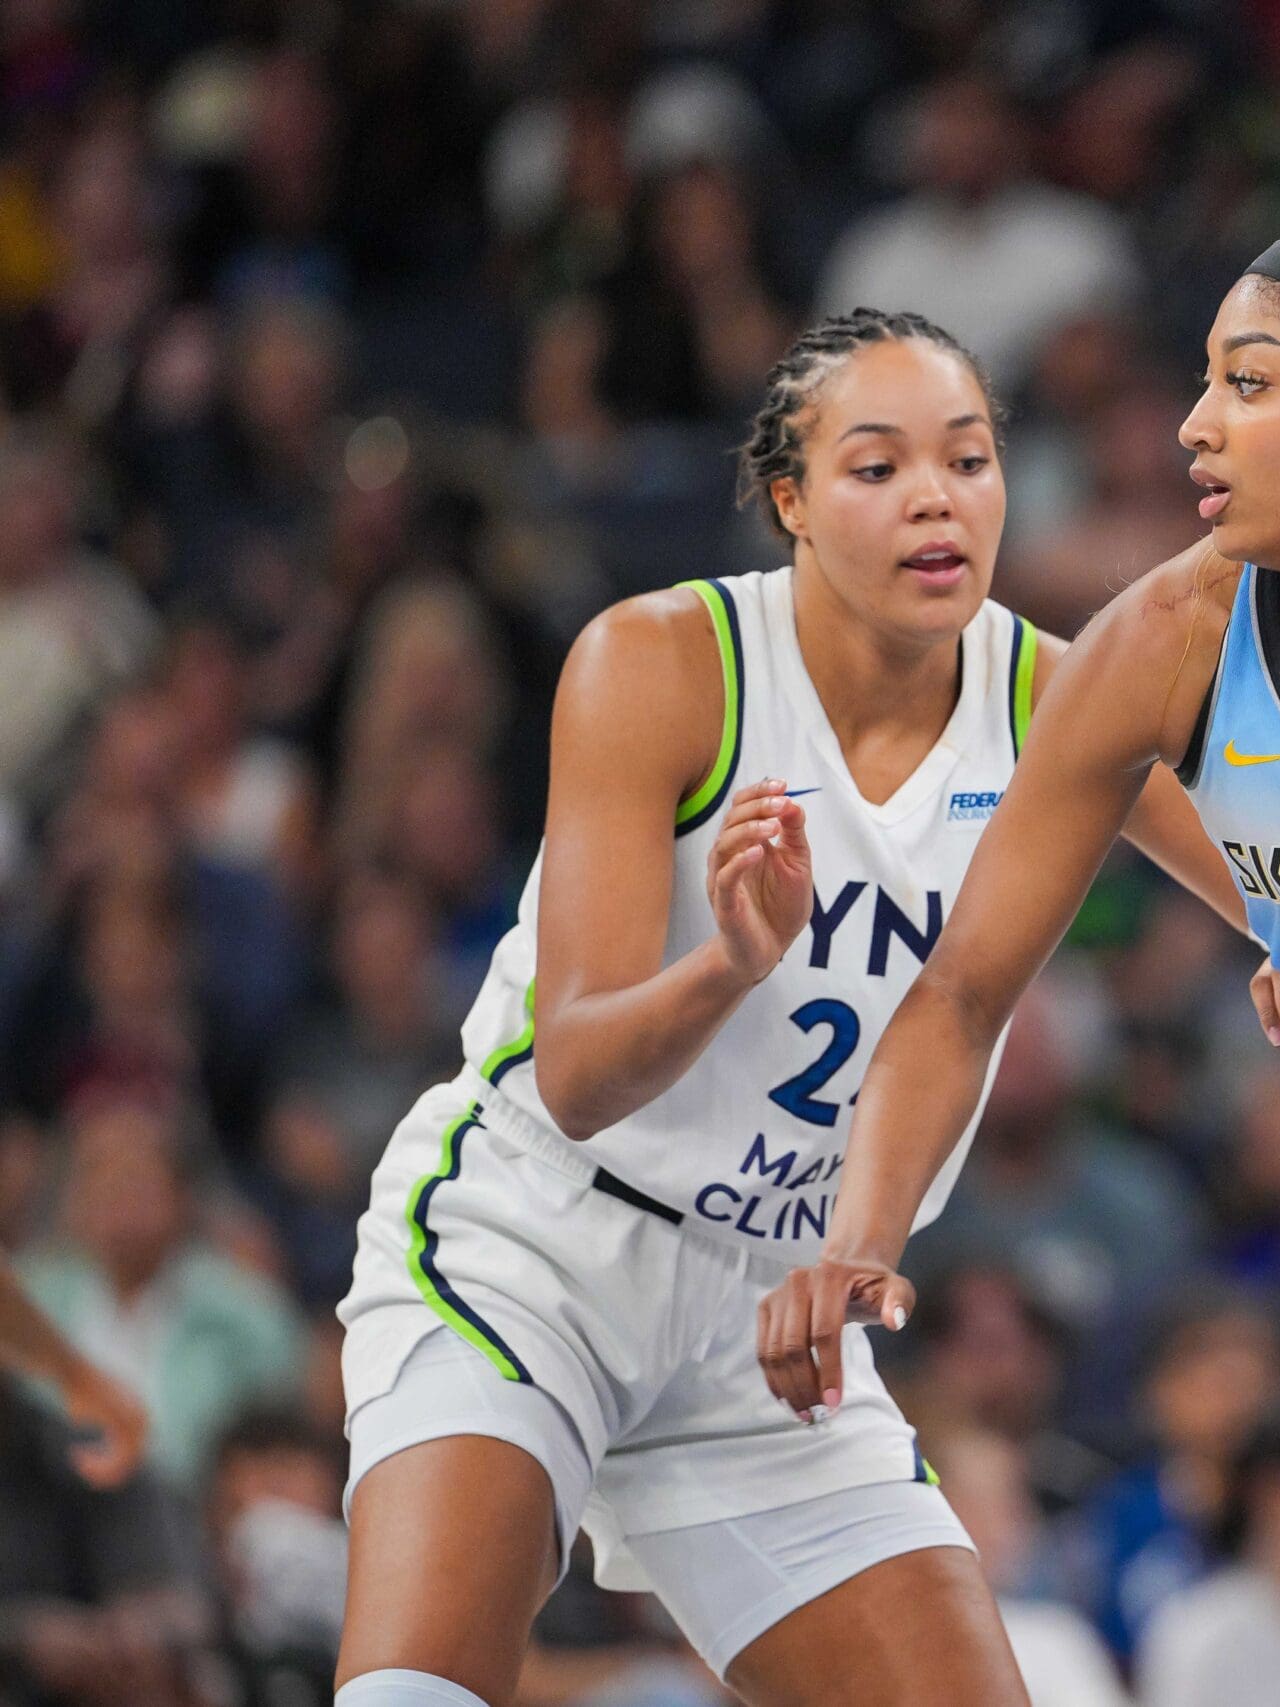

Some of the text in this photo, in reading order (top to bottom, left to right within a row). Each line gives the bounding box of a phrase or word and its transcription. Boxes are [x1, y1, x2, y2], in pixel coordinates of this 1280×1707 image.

[809, 880, 943, 977] YN
[768, 998, 859, 1127] 2
[739, 1132, 845, 1190] MAY
[695, 1183, 838, 1240] CLIN
